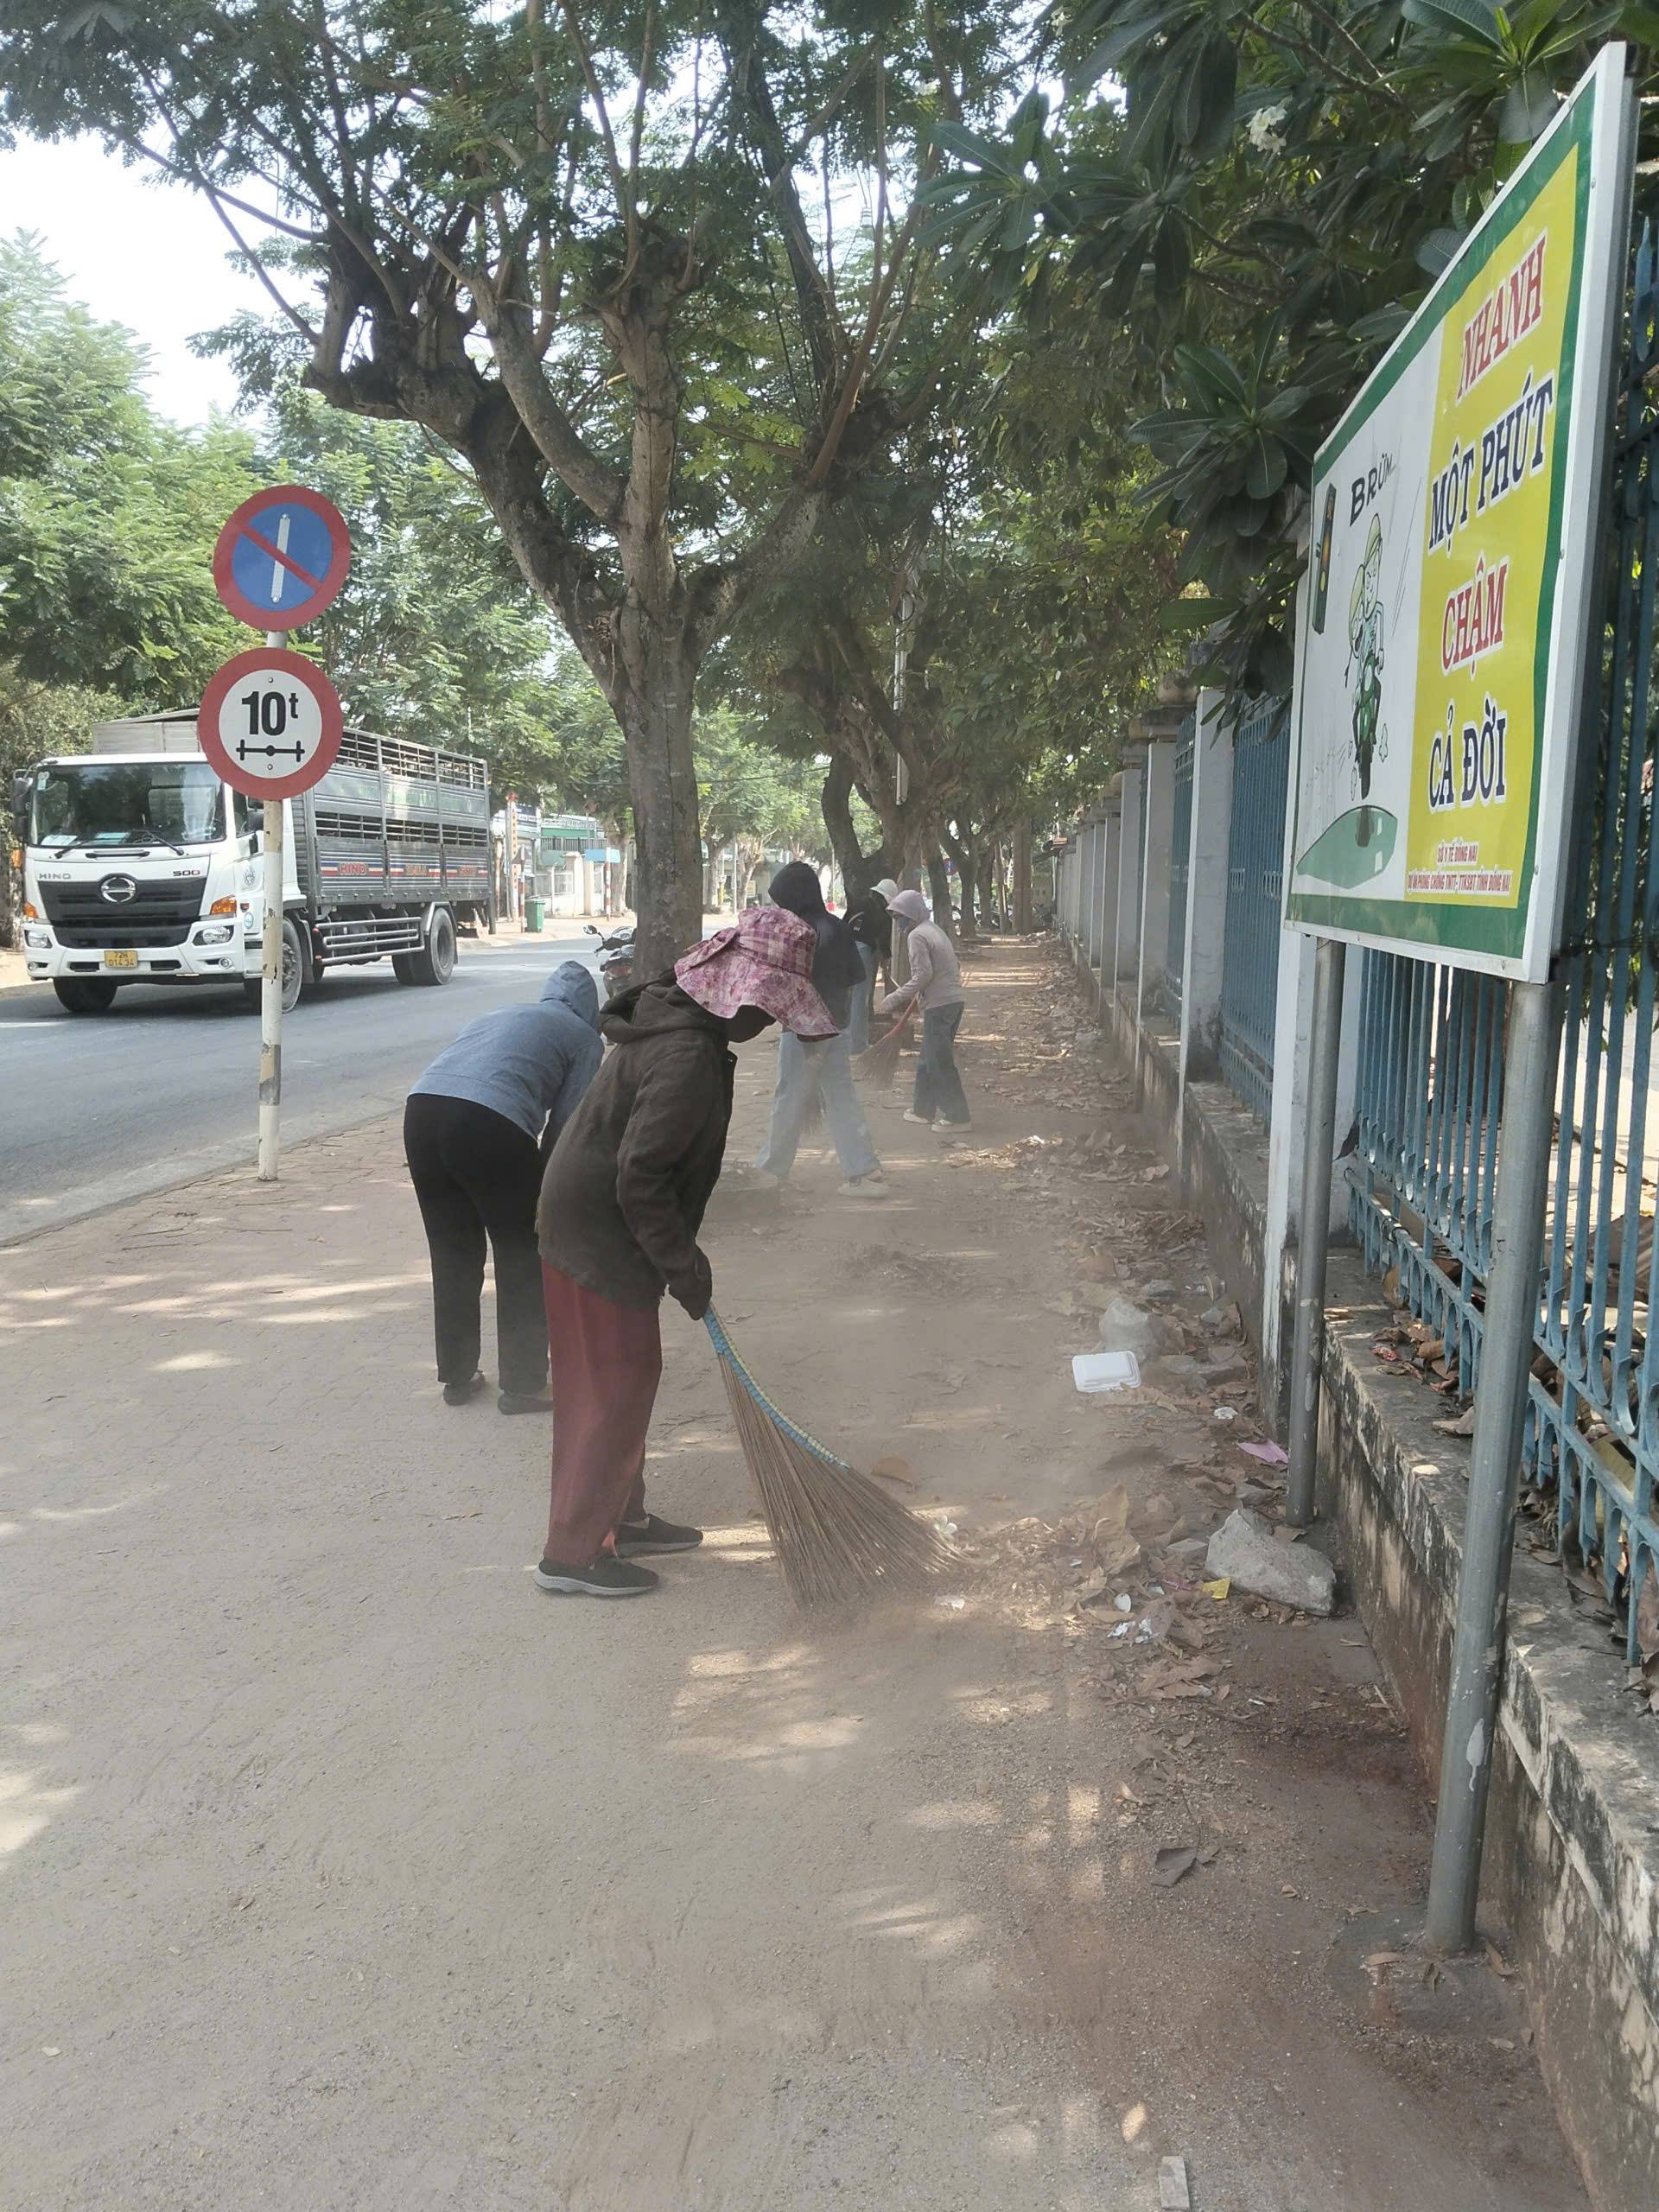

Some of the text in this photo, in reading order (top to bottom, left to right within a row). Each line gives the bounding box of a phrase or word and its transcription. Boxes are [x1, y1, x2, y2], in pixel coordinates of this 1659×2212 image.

[1458, 236, 1546, 397] NHANH
[1429, 373, 1554, 550] MỘT PHÚT
[1441, 558, 1507, 674] CHẬM
[1429, 700, 1507, 809] CẢ ĐỜI
